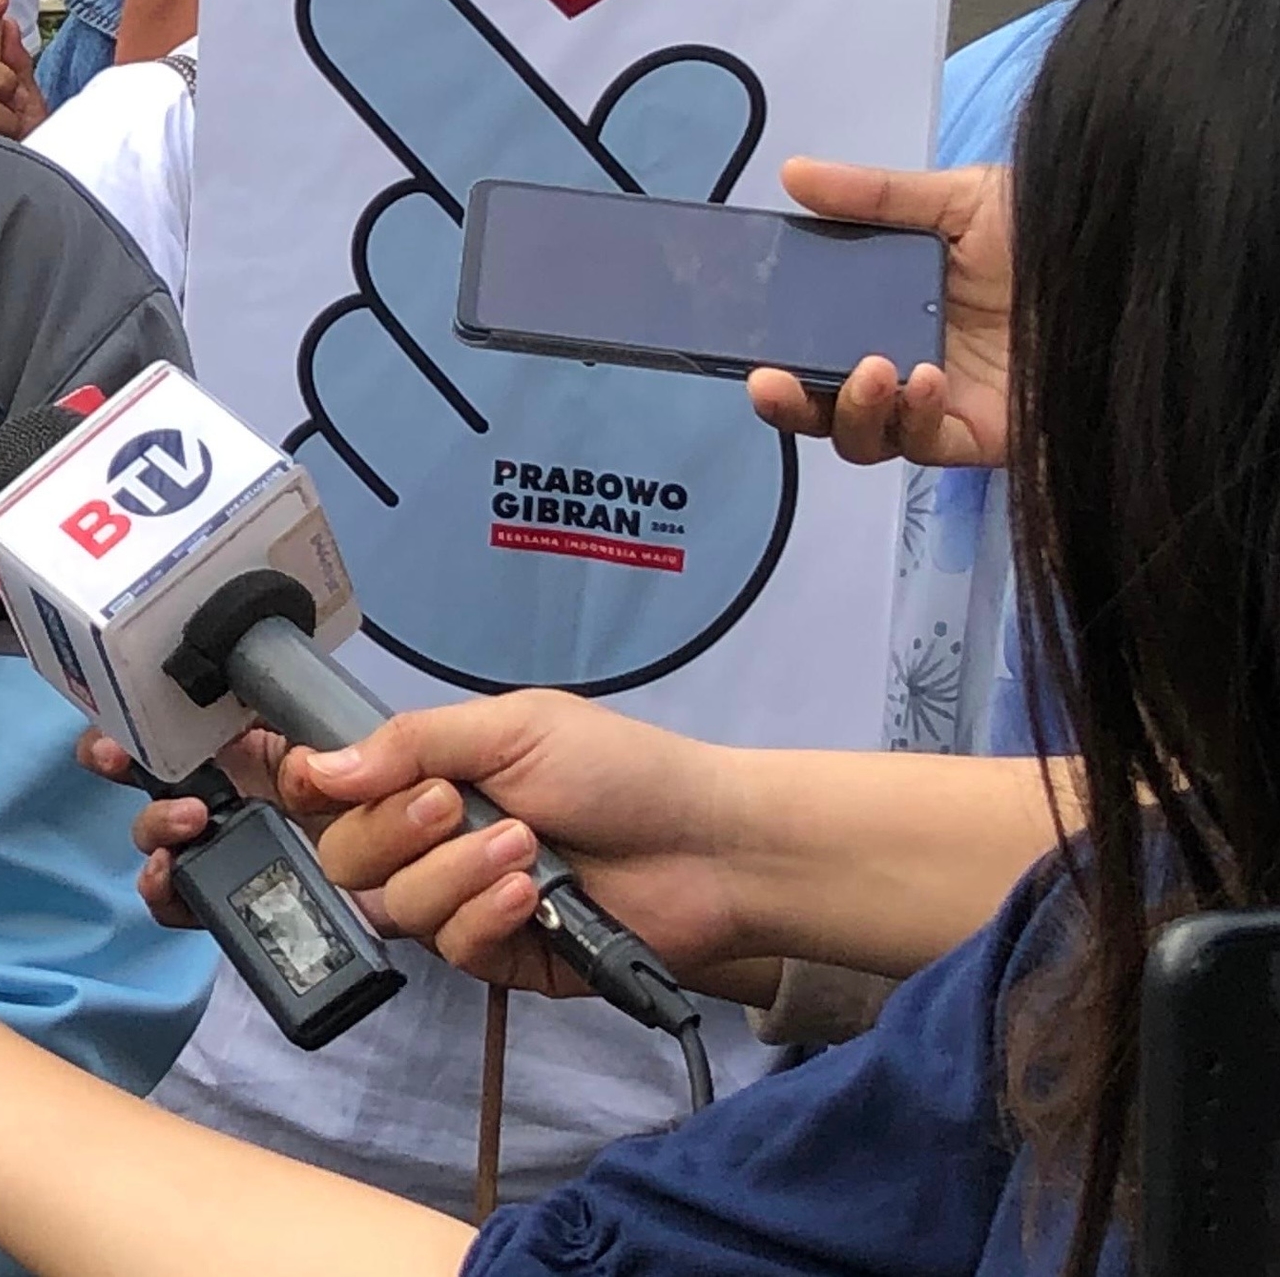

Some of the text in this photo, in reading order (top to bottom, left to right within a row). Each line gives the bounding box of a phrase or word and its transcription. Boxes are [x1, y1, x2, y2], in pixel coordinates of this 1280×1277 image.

[59, 428, 212, 560] BTV
[493, 460, 687, 510] PRABOWO
[492, 492, 685, 537] GIBRAN 2024
[498, 531, 559, 548] BERSAMA
[564, 538, 637, 559] INDONESIA
